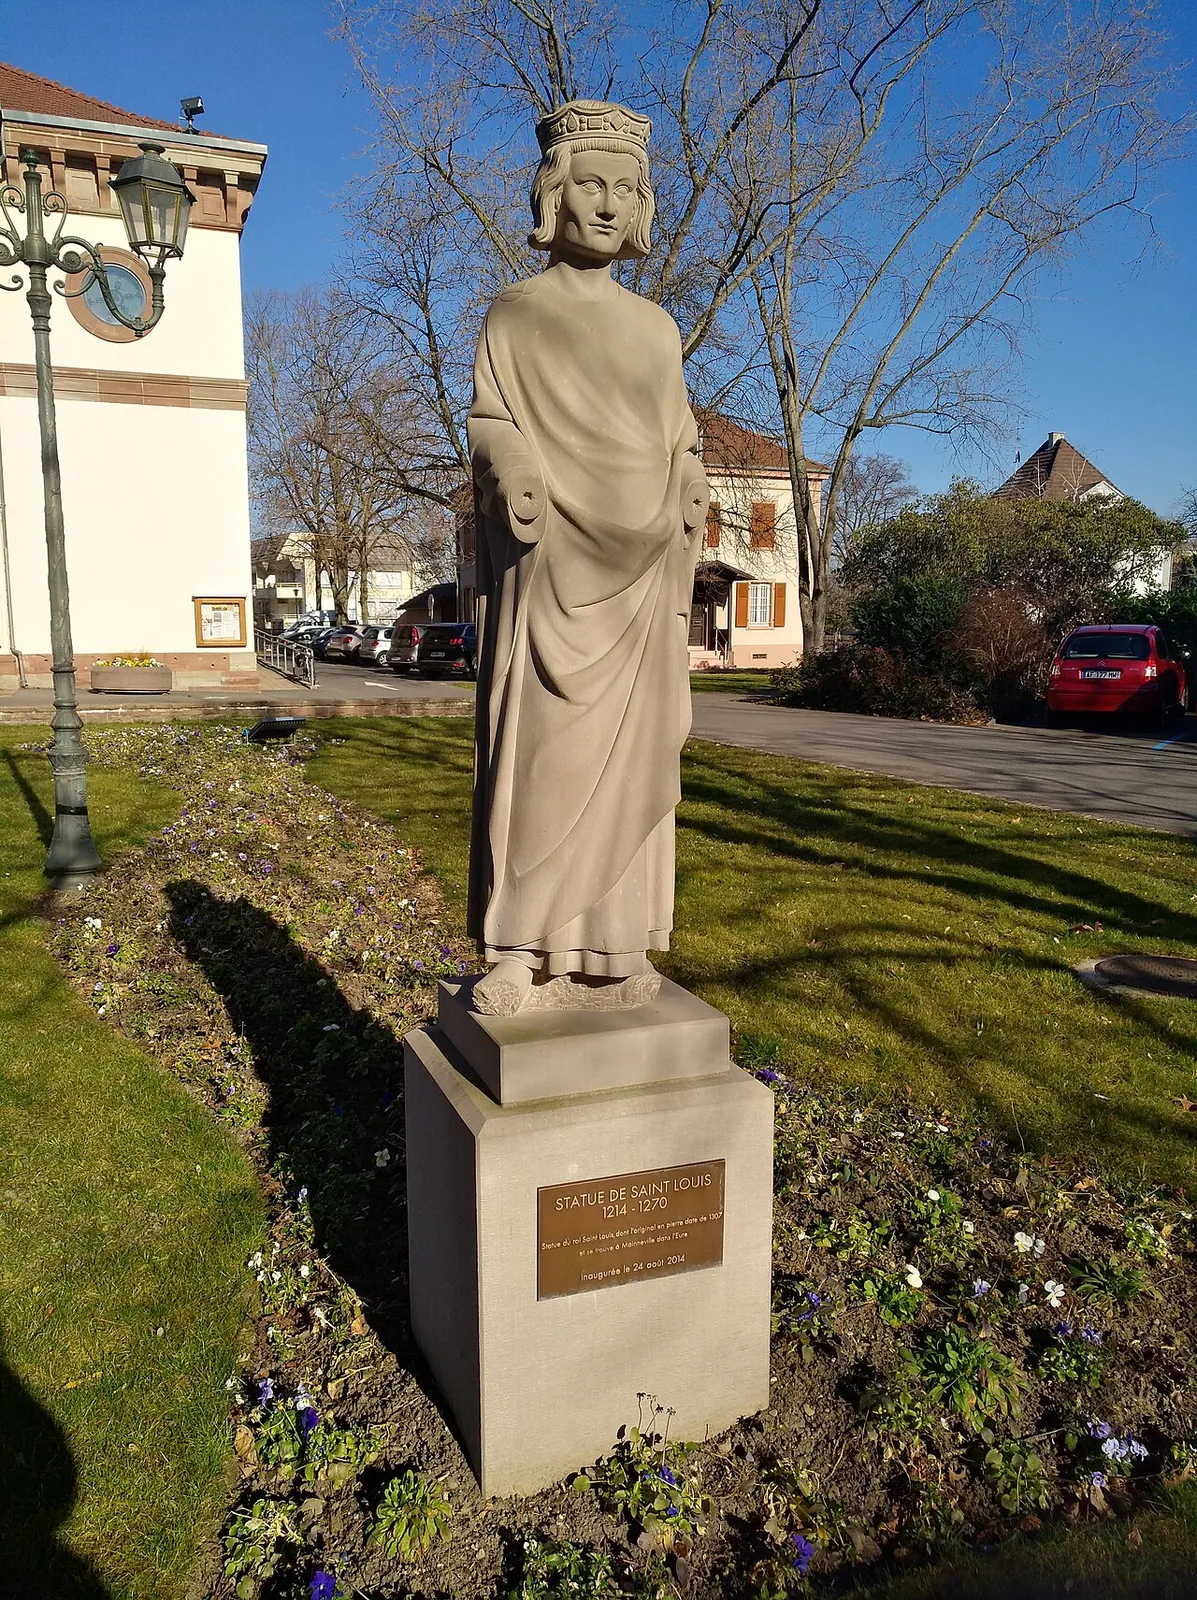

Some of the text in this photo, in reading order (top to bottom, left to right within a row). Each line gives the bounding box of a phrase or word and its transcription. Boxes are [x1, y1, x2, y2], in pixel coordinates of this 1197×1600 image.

[555, 1174, 712, 1211] STATUE DE SAINT LOUIS
[602, 1203, 627, 1219] 1214
[638, 1196, 668, 1213] 1270
[541, 1242, 561, 1250] Statue
[562, 1238, 571, 1247] du
[572, 1237, 581, 1245] roi
[582, 1235, 598, 1243] Saint
[615, 1229, 630, 1237] dont
[630, 1223, 657, 1234] l'original
[666, 1220, 684, 1230] pierre
[684, 1217, 698, 1225] date
[708, 1212, 723, 1220] 1307
[595, 1245, 614, 1253] trouve
[621, 1237, 655, 1249] Mainneville
[656, 1235, 671, 1243] dans
[672, 1232, 688, 1240] l'Eure
[580, 1254, 686, 1281] inaugurée le 24 août 2014
